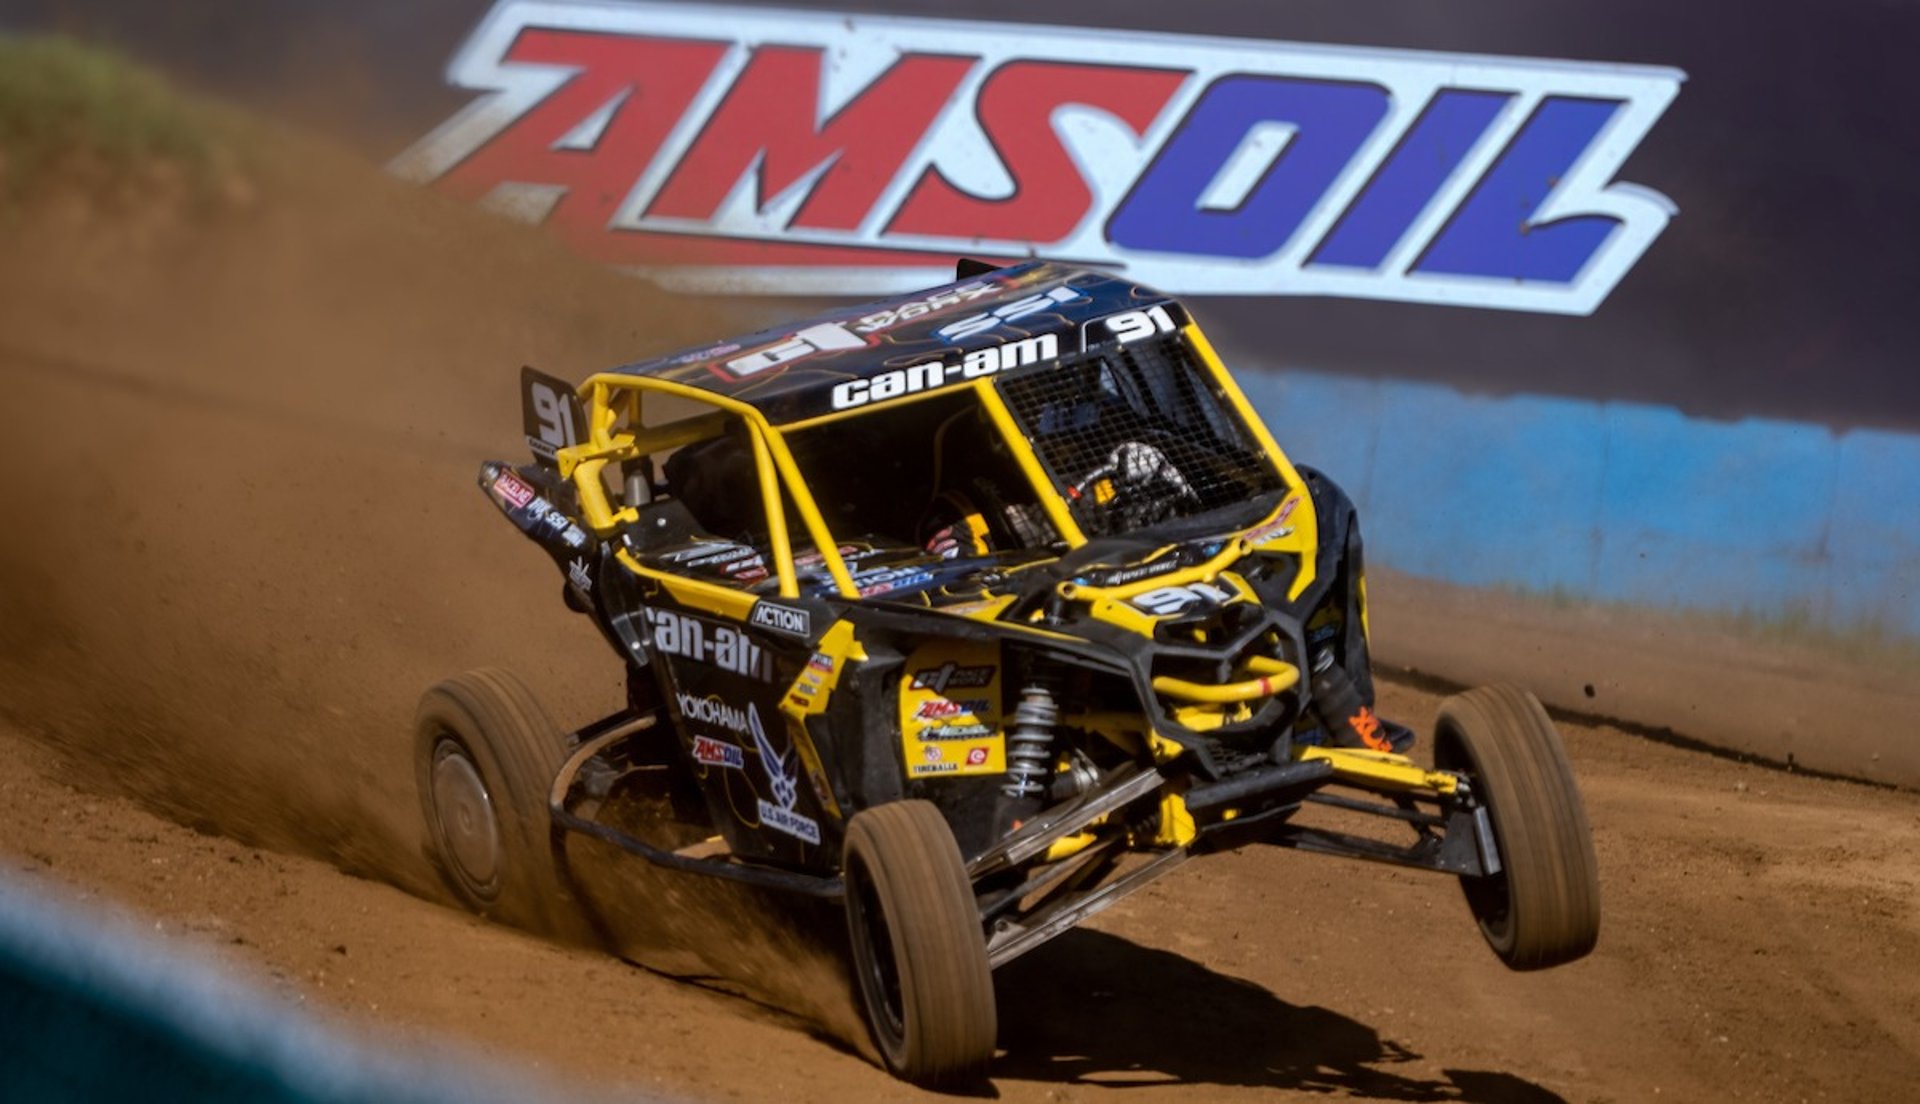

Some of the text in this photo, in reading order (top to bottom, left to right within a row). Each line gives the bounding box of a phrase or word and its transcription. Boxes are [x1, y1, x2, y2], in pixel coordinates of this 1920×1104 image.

[430, 27, 1628, 288] AMSOIL
[1106, 306, 1175, 343] 91
[832, 334, 1058, 410] can-am
[531, 381, 577, 449] 91
[1133, 582, 1231, 614] 91
[756, 605, 804, 632] ACTION
[676, 692, 750, 735] YOKOHAMA
[694, 737, 743, 767] AMSOIL
[789, 815, 818, 840] FORCE
